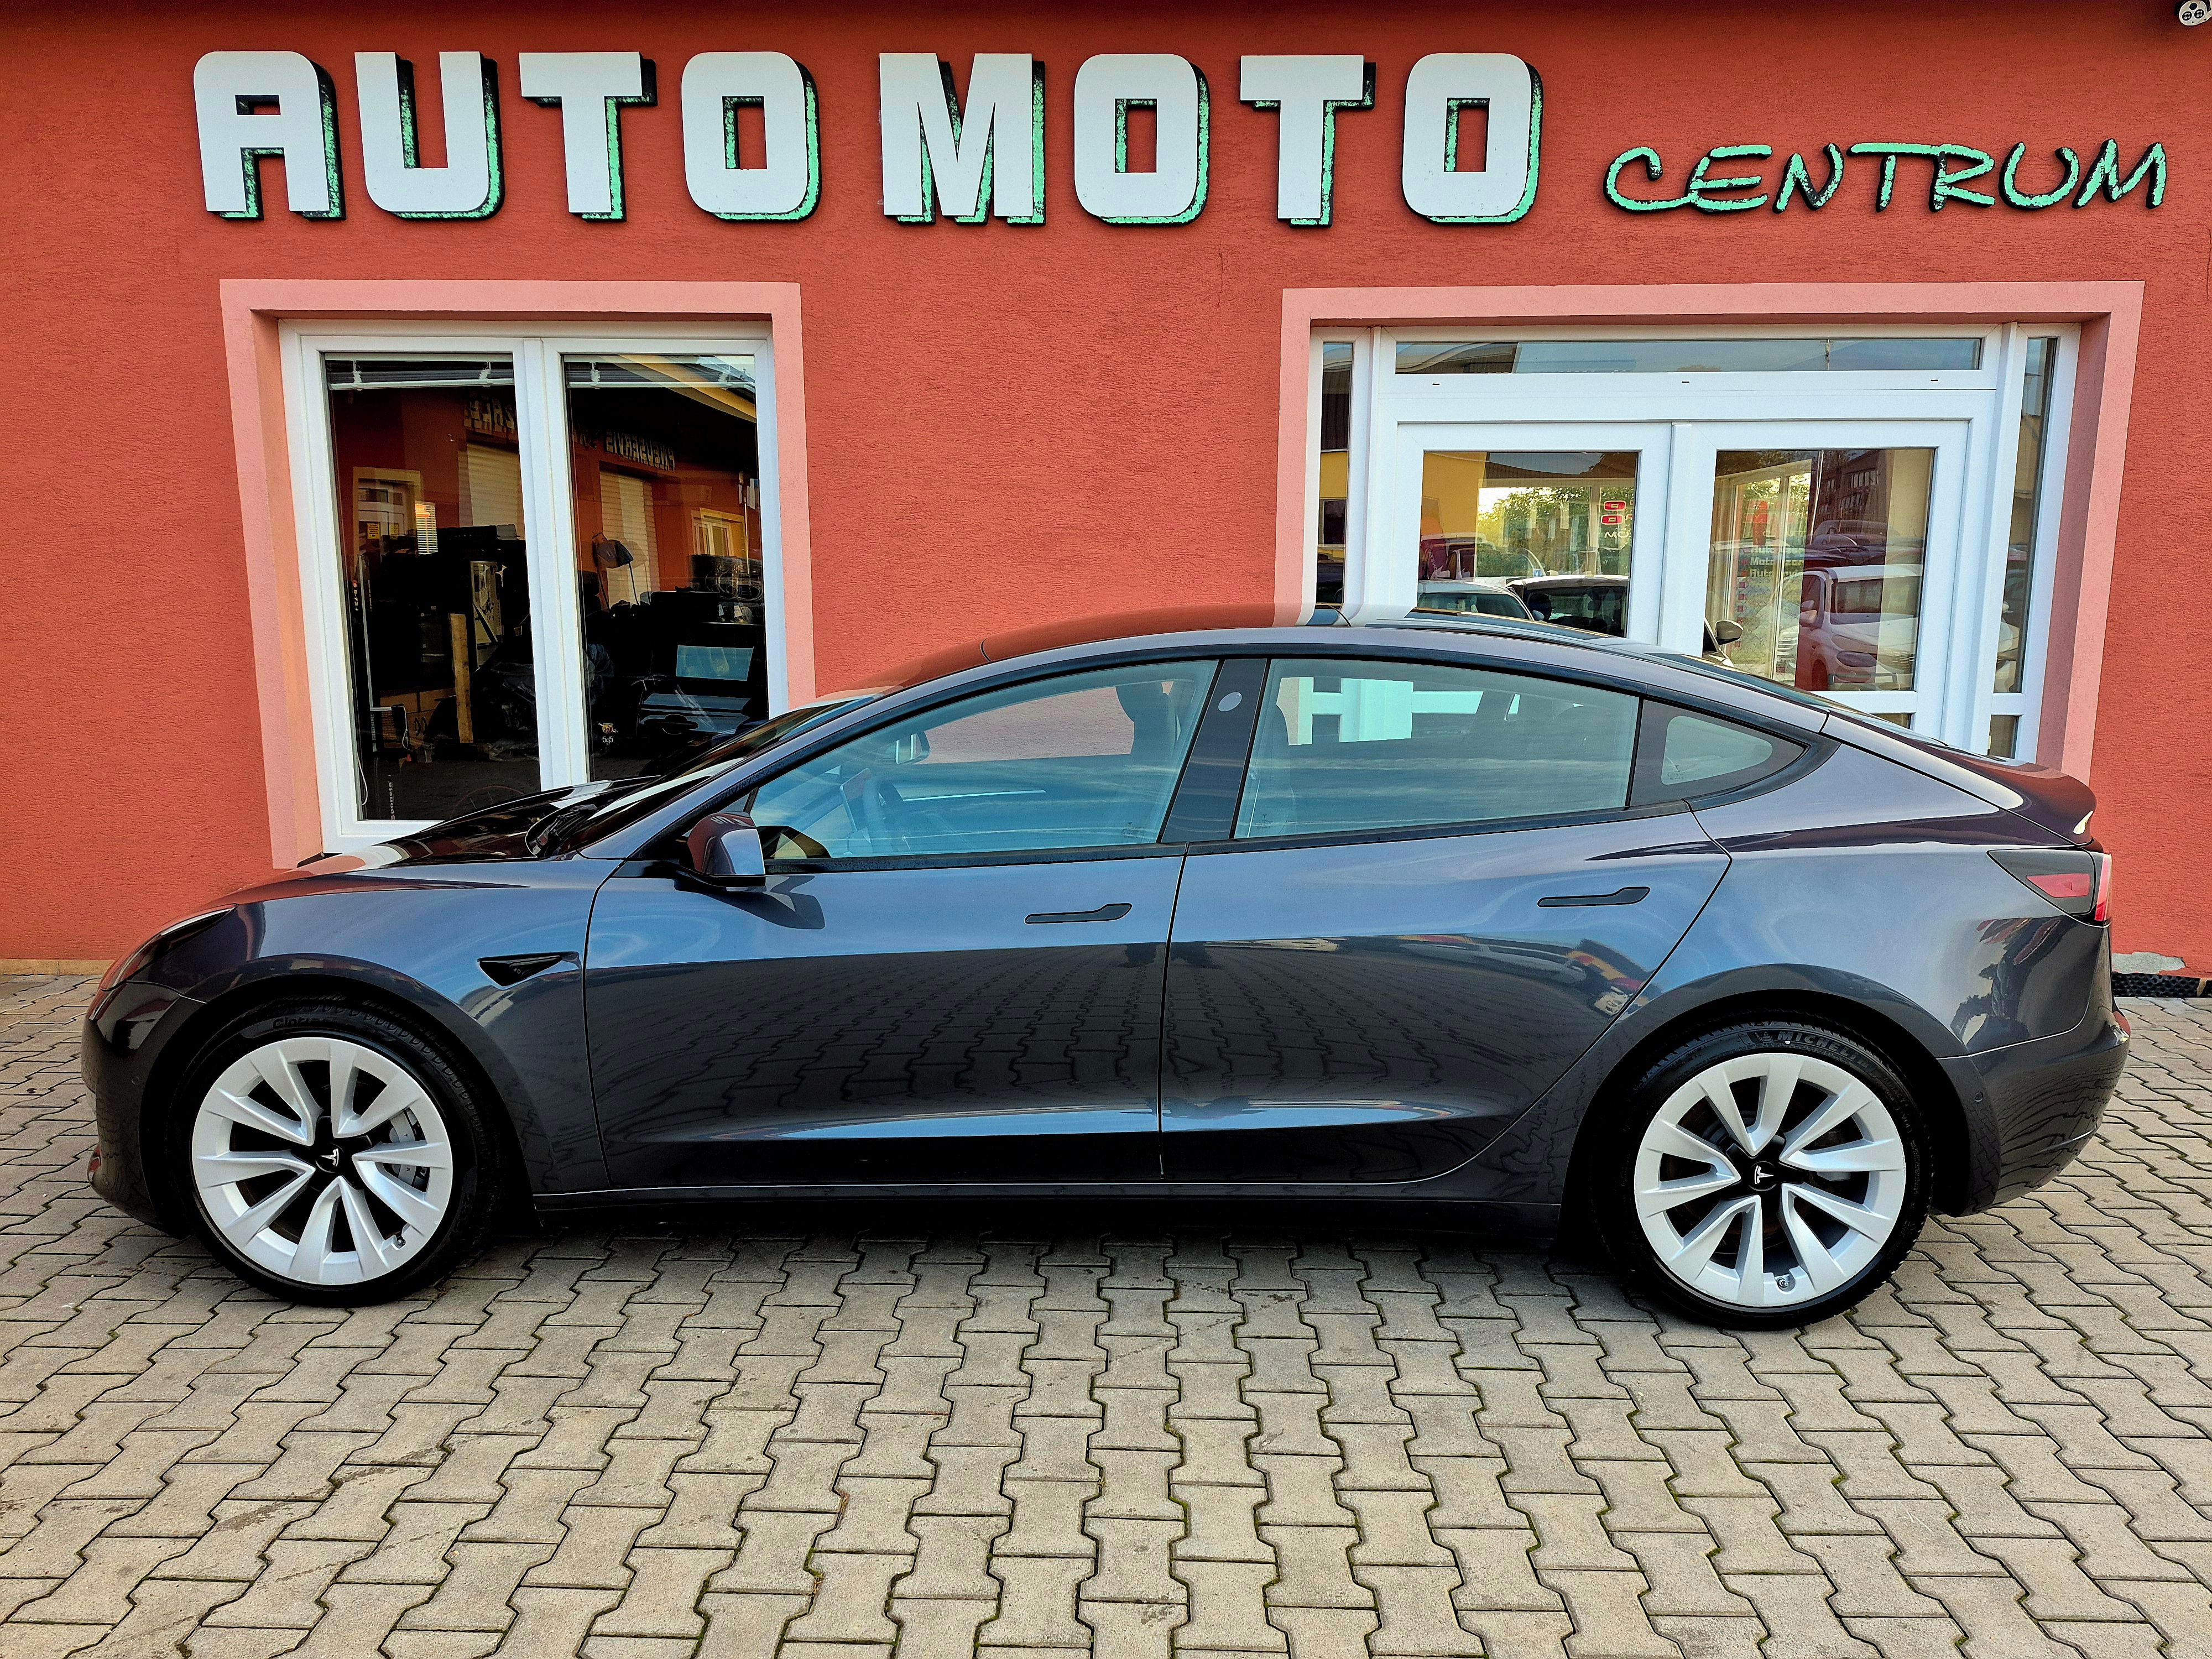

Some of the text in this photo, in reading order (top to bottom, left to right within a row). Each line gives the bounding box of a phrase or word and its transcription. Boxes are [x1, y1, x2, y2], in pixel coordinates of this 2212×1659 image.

[193, 51, 2168, 226] AUTO MOTO CENTRUM
[602, 736, 613, 745] 595
[1776, 1031, 1869, 1070] MICHELIN
